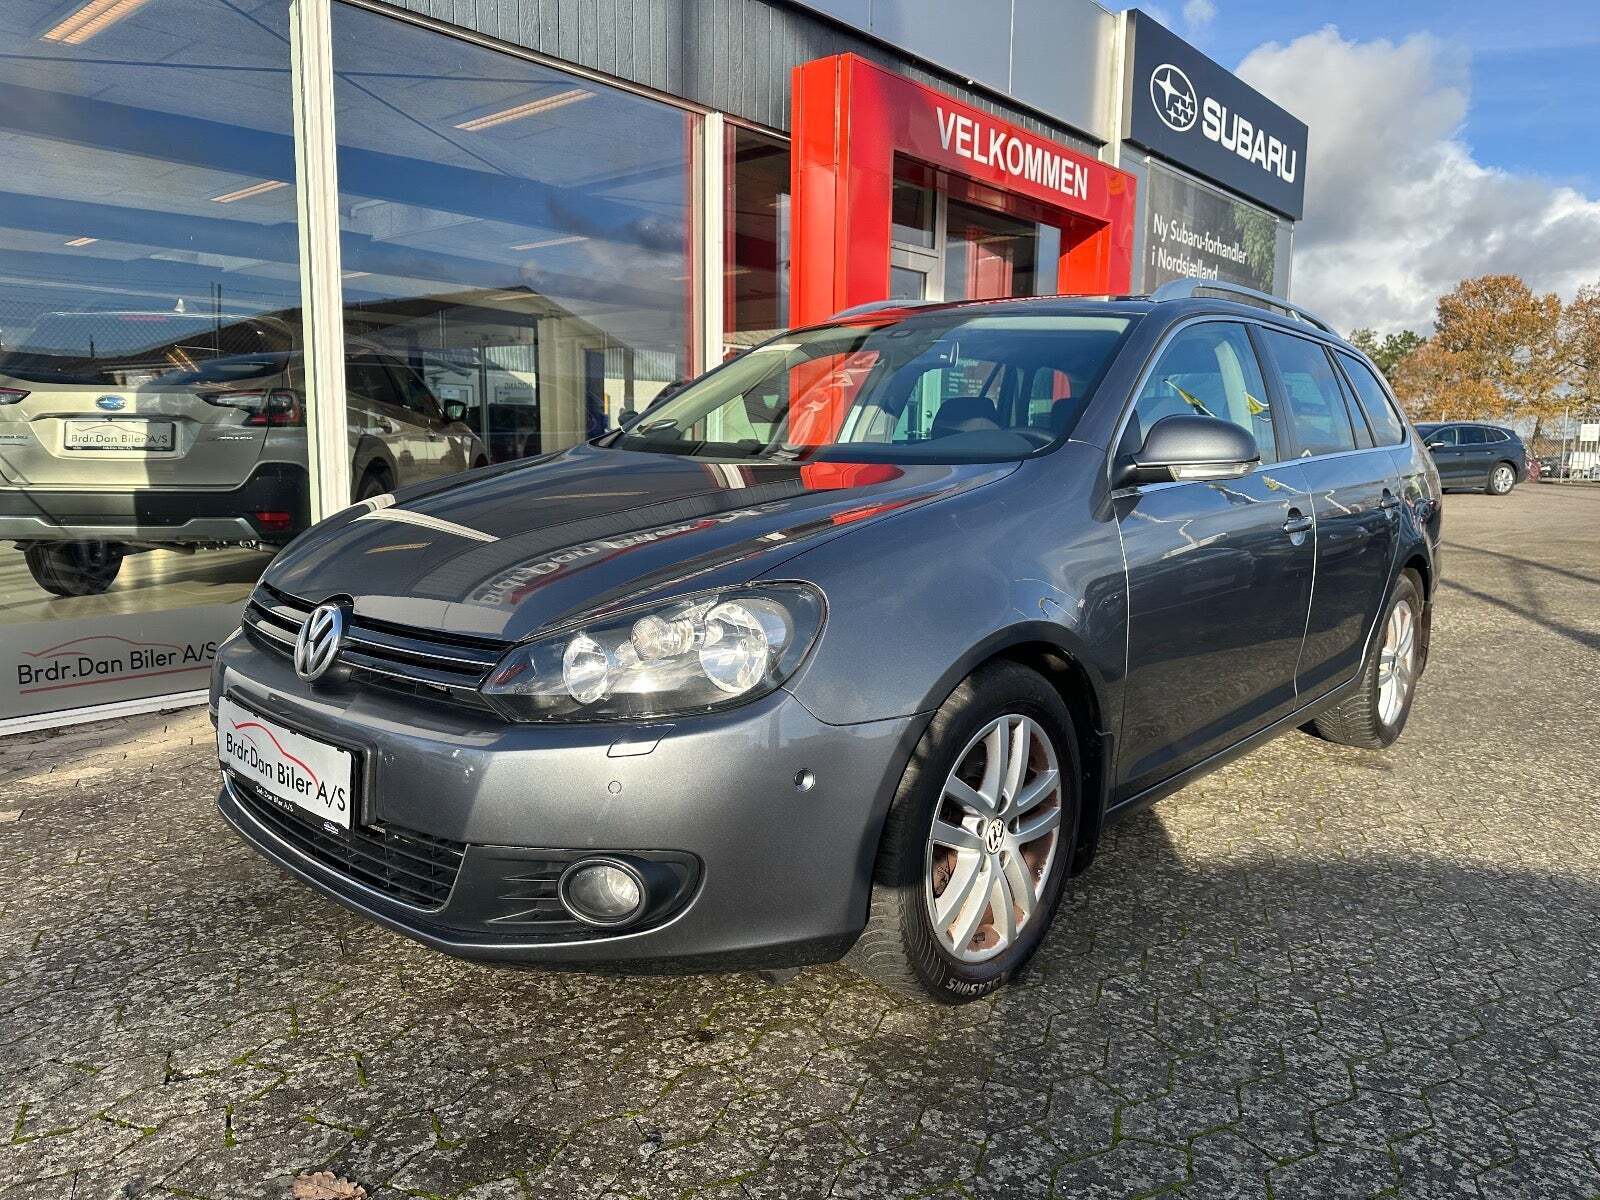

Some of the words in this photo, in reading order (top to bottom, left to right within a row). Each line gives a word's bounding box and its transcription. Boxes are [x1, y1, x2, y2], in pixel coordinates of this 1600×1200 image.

[936, 106, 1089, 200] VELKOMMEN
[1202, 96, 1297, 184] SUBARU
[1153, 214, 1168, 238] Ny
[1170, 219, 1248, 264] Subaru-forhandler
[1151, 251, 1156, 266] i
[1157, 249, 1218, 280] Nordsjælland
[71, 434, 118, 443] Brdr.Dan
[121, 434, 146, 443] Biler
[148, 434, 168, 443] A/S
[17, 657, 122, 685] Brdr.Dan
[130, 650, 177, 670] Biler
[182, 641, 217, 663] A/S
[226, 733, 273, 779] Brdr.Dan
[278, 761, 313, 797] Biler
[317, 780, 346, 812] A/S
